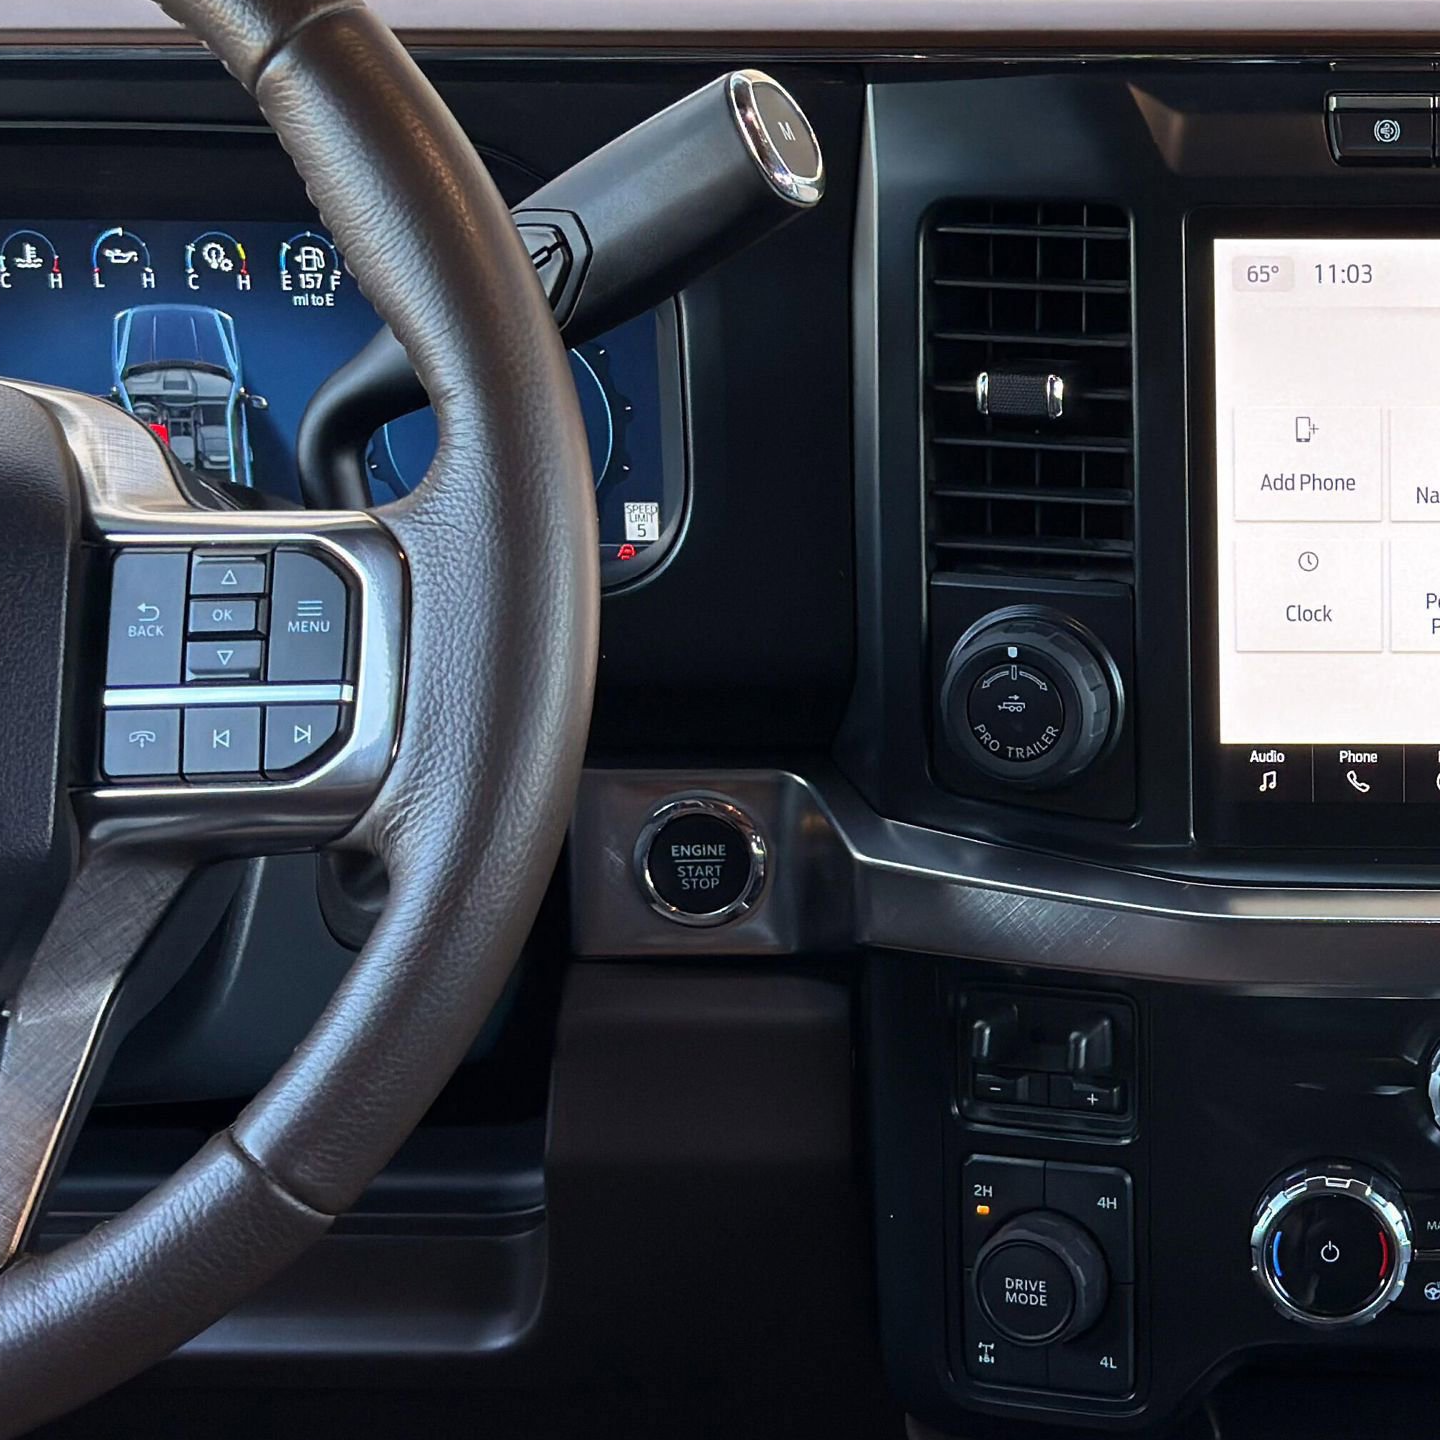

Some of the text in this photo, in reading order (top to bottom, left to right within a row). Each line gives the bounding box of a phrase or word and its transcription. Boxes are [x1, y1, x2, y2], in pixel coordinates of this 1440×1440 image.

[1248, 264, 1372, 283] 65° 11:03
[0, 273, 11, 288] C
[50, 273, 62, 288] H
[94, 273, 105, 287] L
[143, 273, 155, 288] H
[189, 274, 199, 289] C
[238, 275, 250, 290] H
[281, 271, 340, 291] E 157 F
[311, 294, 324, 306] to
[326, 294, 334, 306] E
[1261, 474, 1355, 491] Add Phone
[626, 505, 658, 513] SPEED
[629, 514, 653, 522] LIMIT
[638, 524, 646, 537] 5
[213, 609, 232, 621] OK
[1287, 605, 1332, 621] Clock
[129, 625, 163, 637] BACK
[288, 621, 329, 632] MENU
[1250, 750, 1284, 762] Audio
[1340, 750, 1377, 762] Phone
[672, 845, 725, 856] ENGINE
[678, 865, 720, 877] START
[682, 878, 719, 889] STOP
[974, 1185, 992, 1197] 2H
[1097, 1197, 1116, 1209] 4H
[1006, 1278, 1046, 1292] DRIVE
[1006, 1291, 1047, 1306] MODE
[1100, 1357, 1117, 1368] 4L
